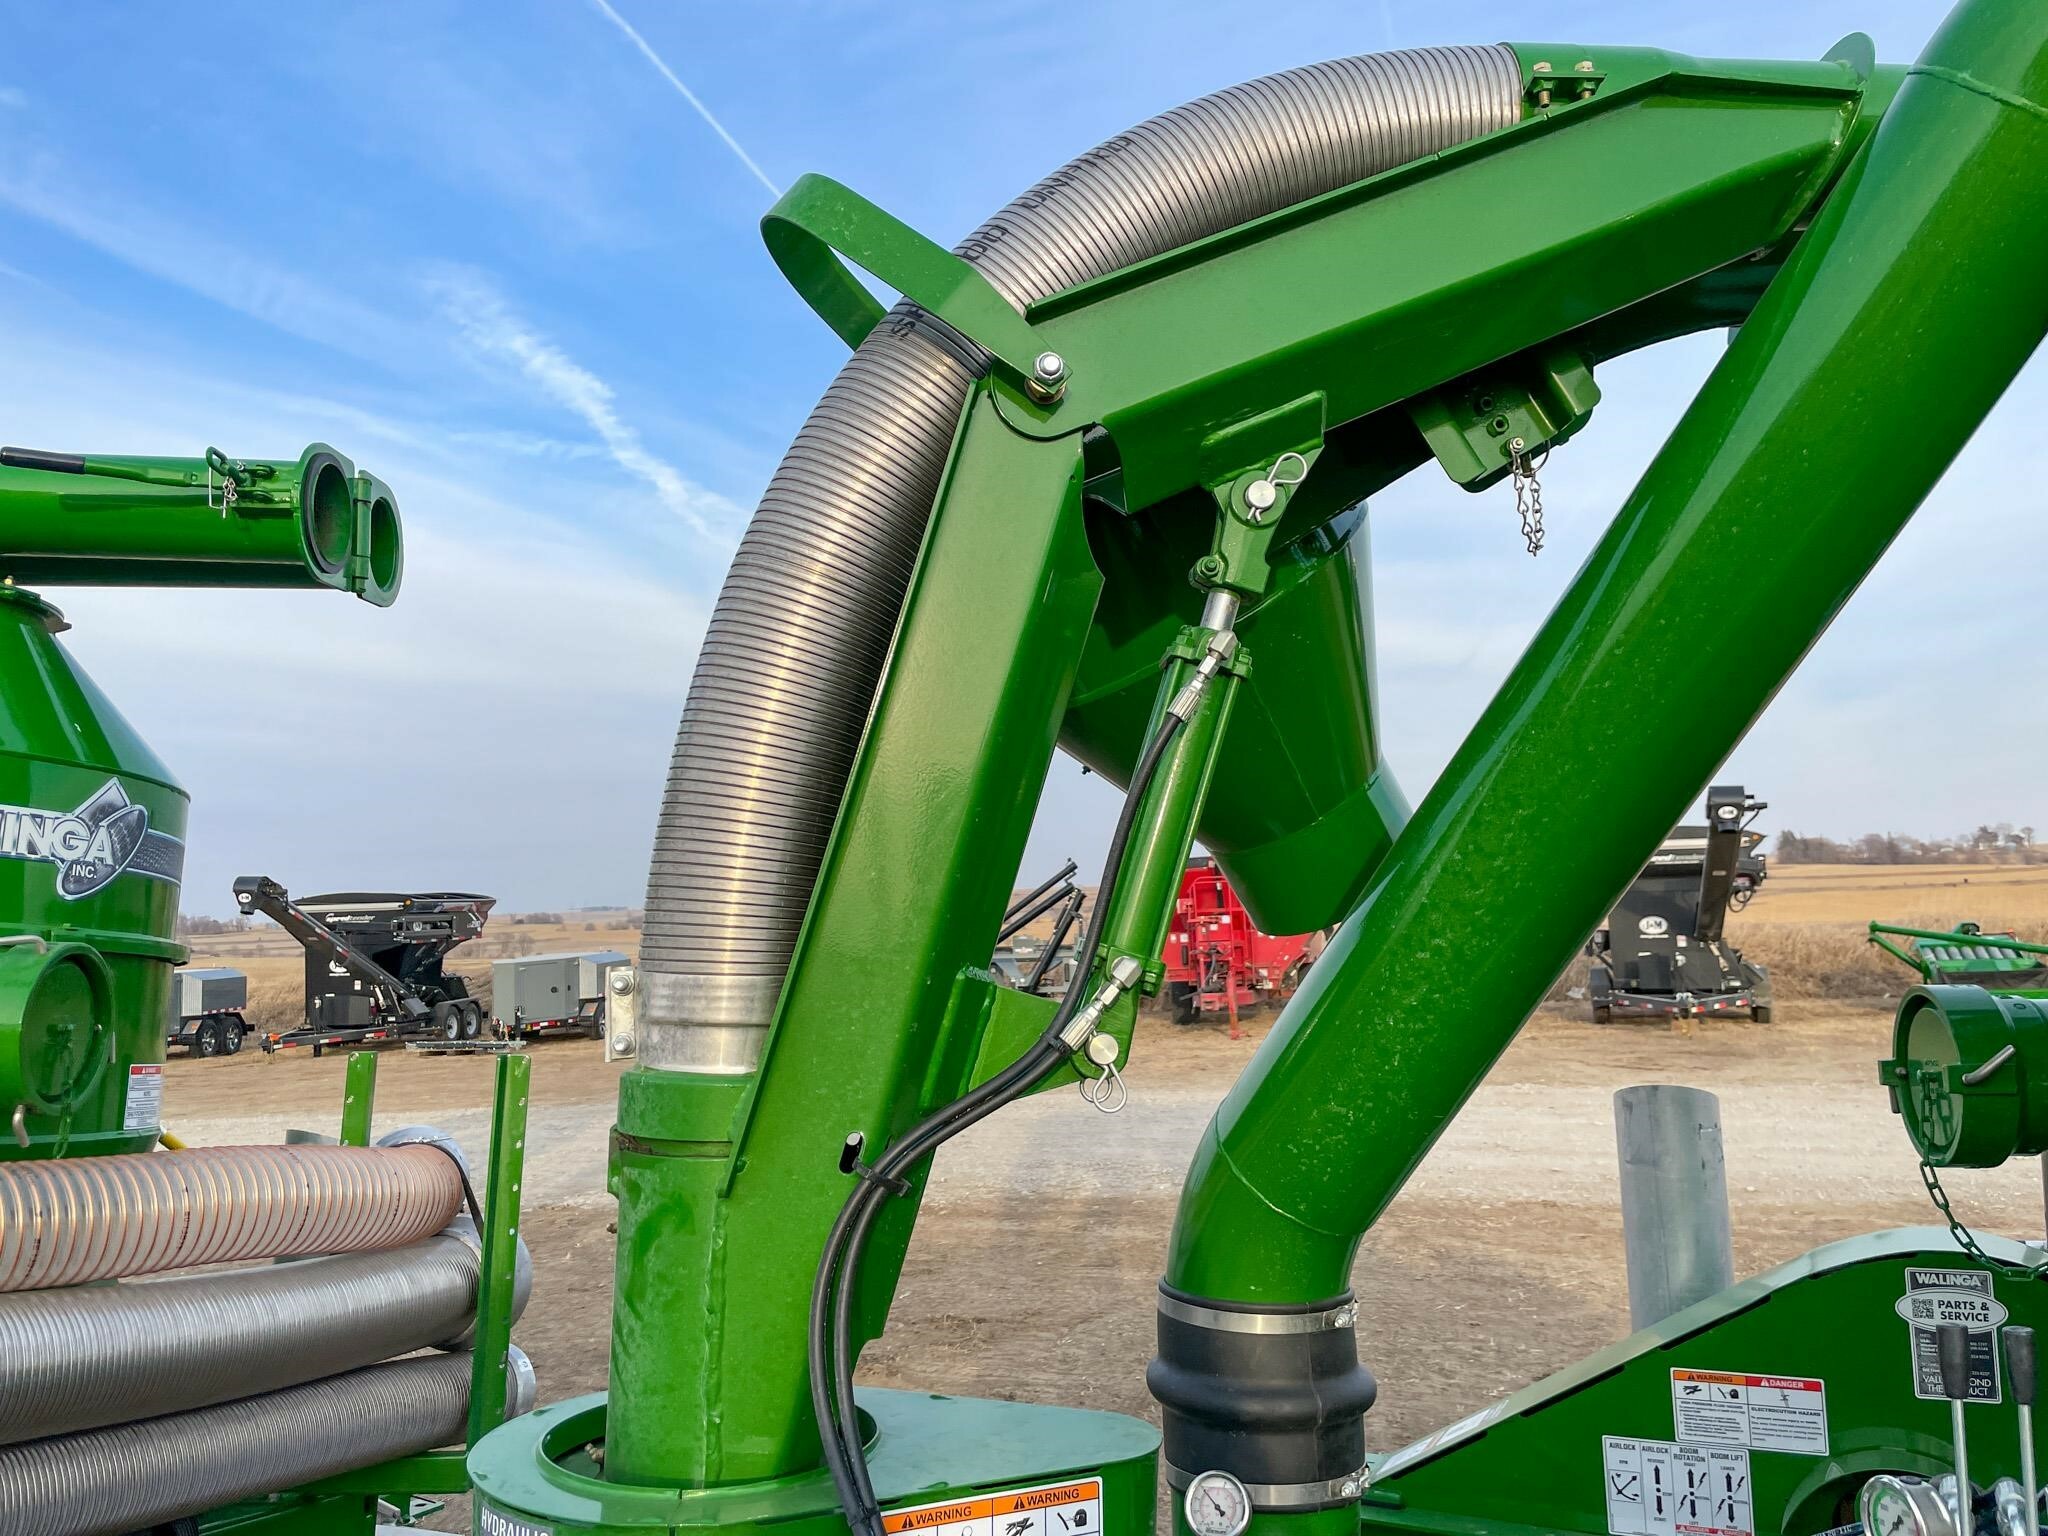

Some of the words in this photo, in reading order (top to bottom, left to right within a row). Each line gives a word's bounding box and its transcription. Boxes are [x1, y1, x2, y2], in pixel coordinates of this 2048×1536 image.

[72, 864, 97, 878] INC.
[1915, 1273, 1982, 1287] WALINGA
[1938, 1299, 1976, 1311] PARTS
[1980, 1302, 1990, 1311] &
[1940, 1311, 1990, 1322] SERVICE
[1696, 1374, 1733, 1383] WARNING
[1770, 1381, 1804, 1389] DANGER
[1609, 1442, 1636, 1451] AIRLOCK
[1642, 1445, 1669, 1454] AIRLOCK
[1679, 1447, 1699, 1455] BOOM
[1673, 1454, 1706, 1462] ROTATION
[1710, 1452, 1729, 1460] BOOM
[1730, 1454, 1743, 1462] LIFT
[1027, 1488, 1080, 1507] WARNING
[916, 1506, 972, 1525] WARNING
[481, 1506, 549, 1536] HYDRA
